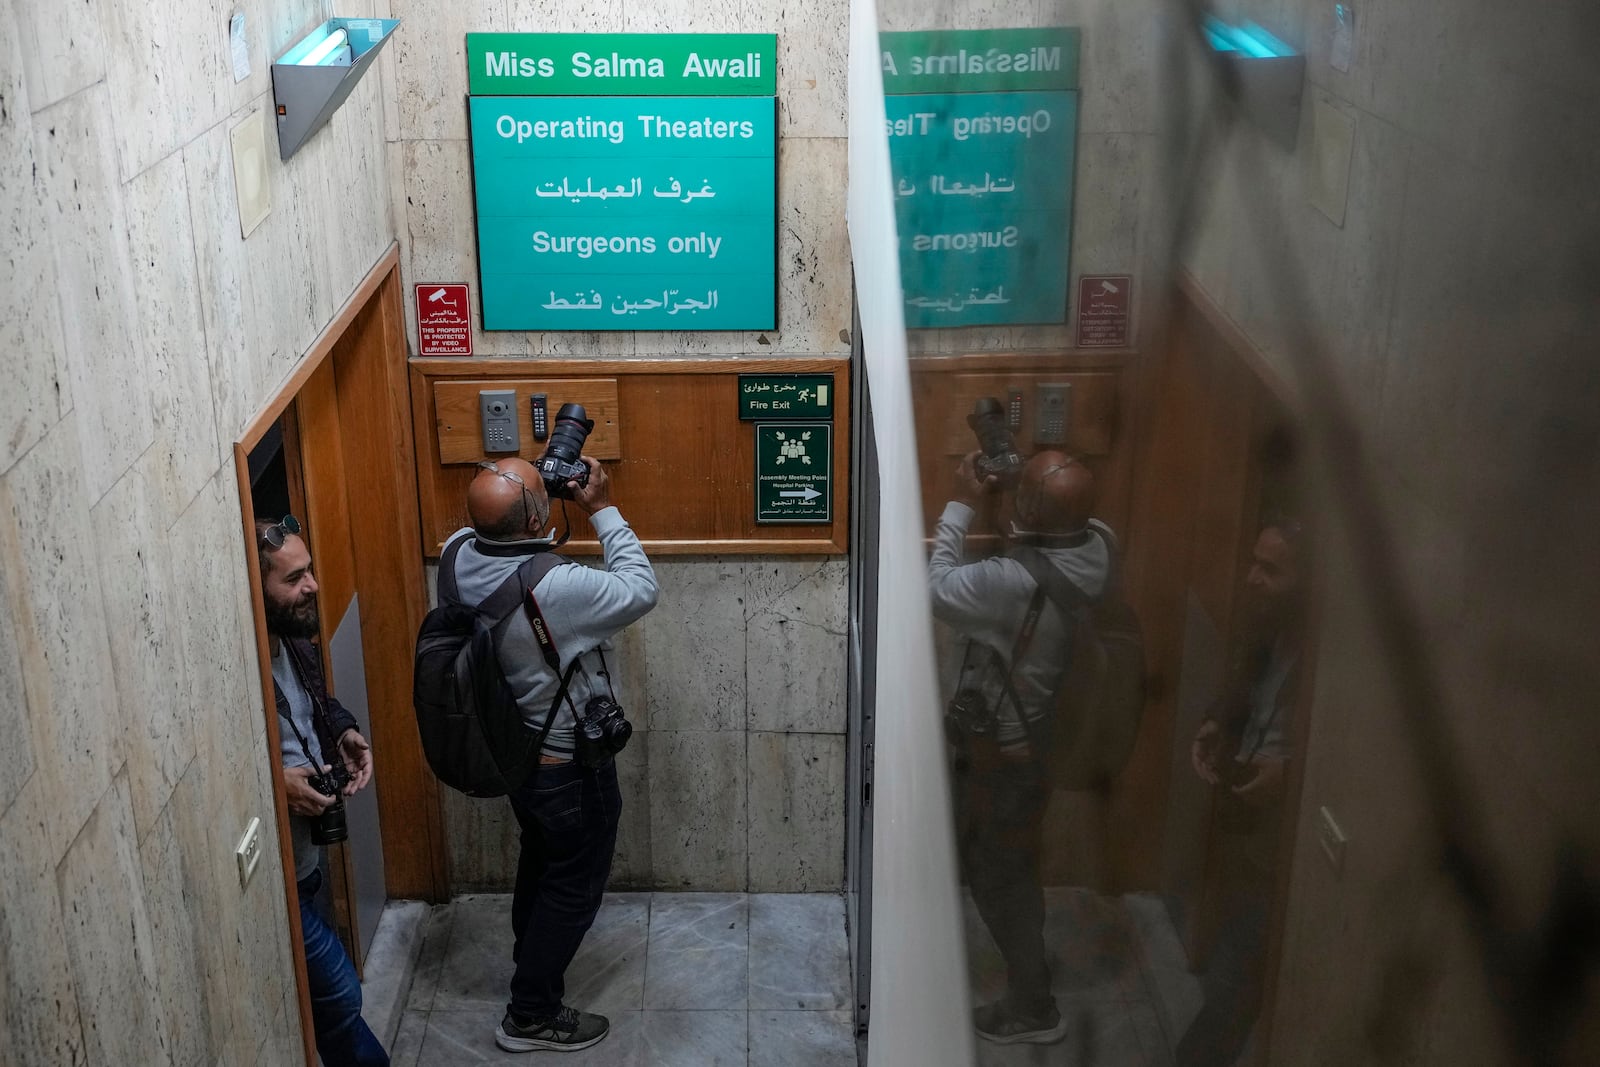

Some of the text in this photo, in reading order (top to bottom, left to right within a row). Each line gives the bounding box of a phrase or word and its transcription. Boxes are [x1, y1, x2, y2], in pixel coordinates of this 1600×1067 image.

[485, 51, 762, 78] Miss Salma Awali
[495, 114, 754, 144] Operating Theaters
[535, 176, 716, 204] غرف العمليات
[532, 231, 722, 259] Surgeons only
[541, 288, 602, 310] فقط
[773, 383, 797, 393] مخرج
[750, 401, 790, 409] Fire Exit
[532, 617, 549, 645] Canon
